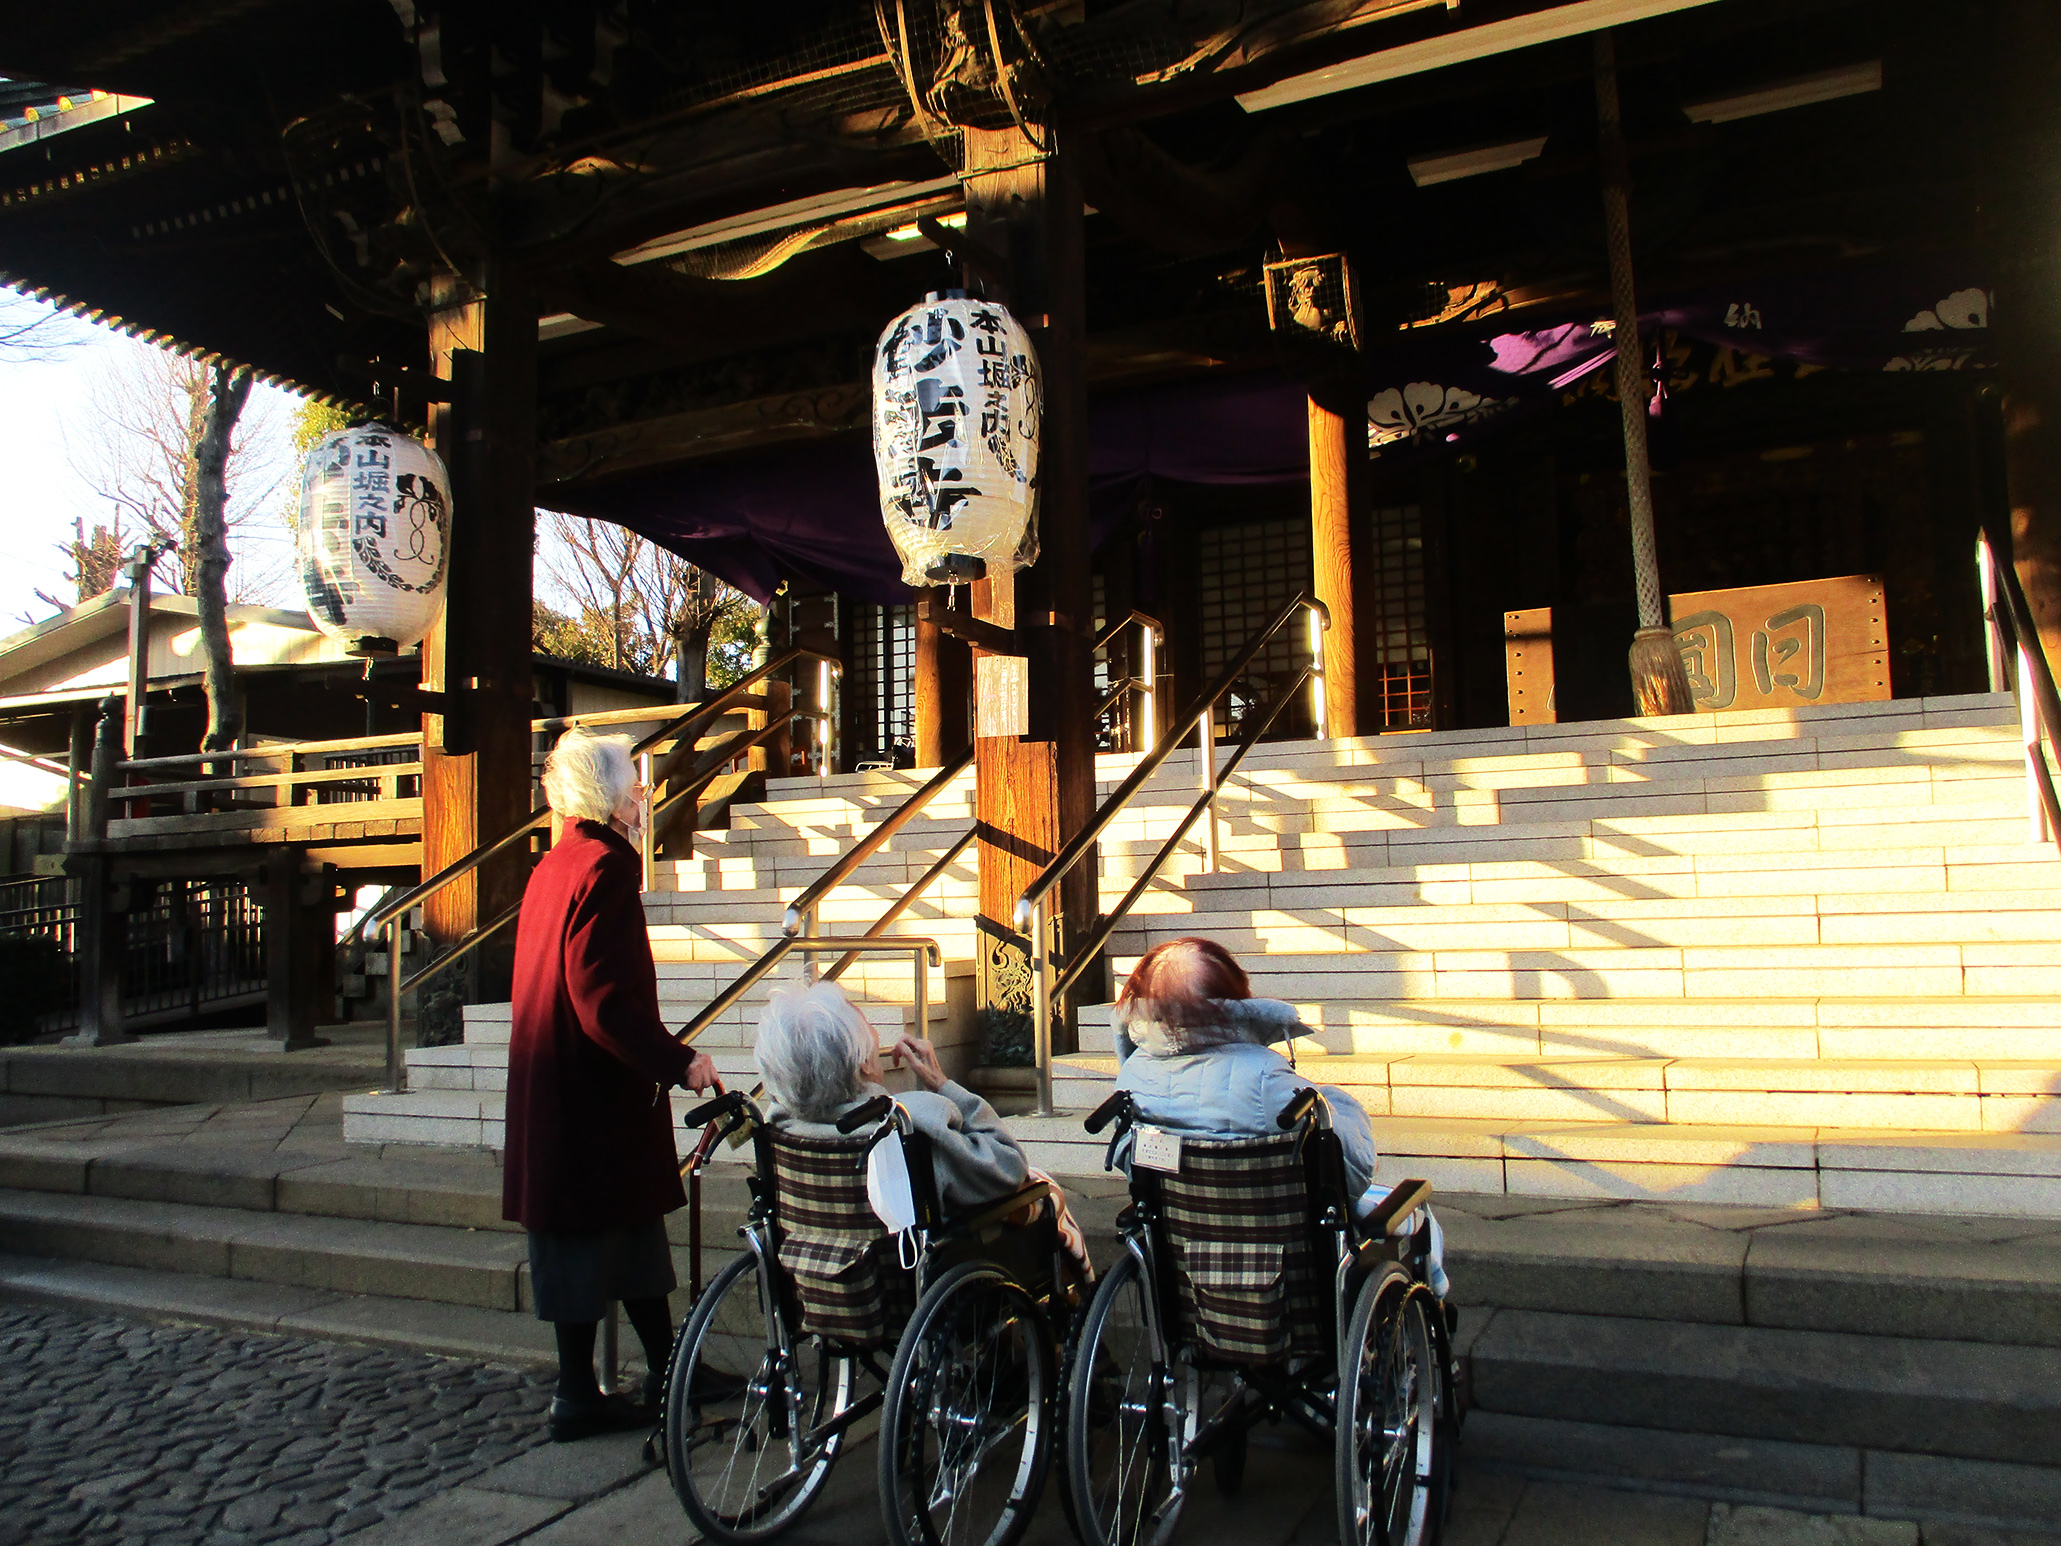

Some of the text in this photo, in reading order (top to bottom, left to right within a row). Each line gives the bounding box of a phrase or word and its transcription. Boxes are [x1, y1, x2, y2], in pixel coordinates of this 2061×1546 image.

[970, 309, 1011, 442] 本山堀之内
[353, 434, 392, 539] 本山堀之内
